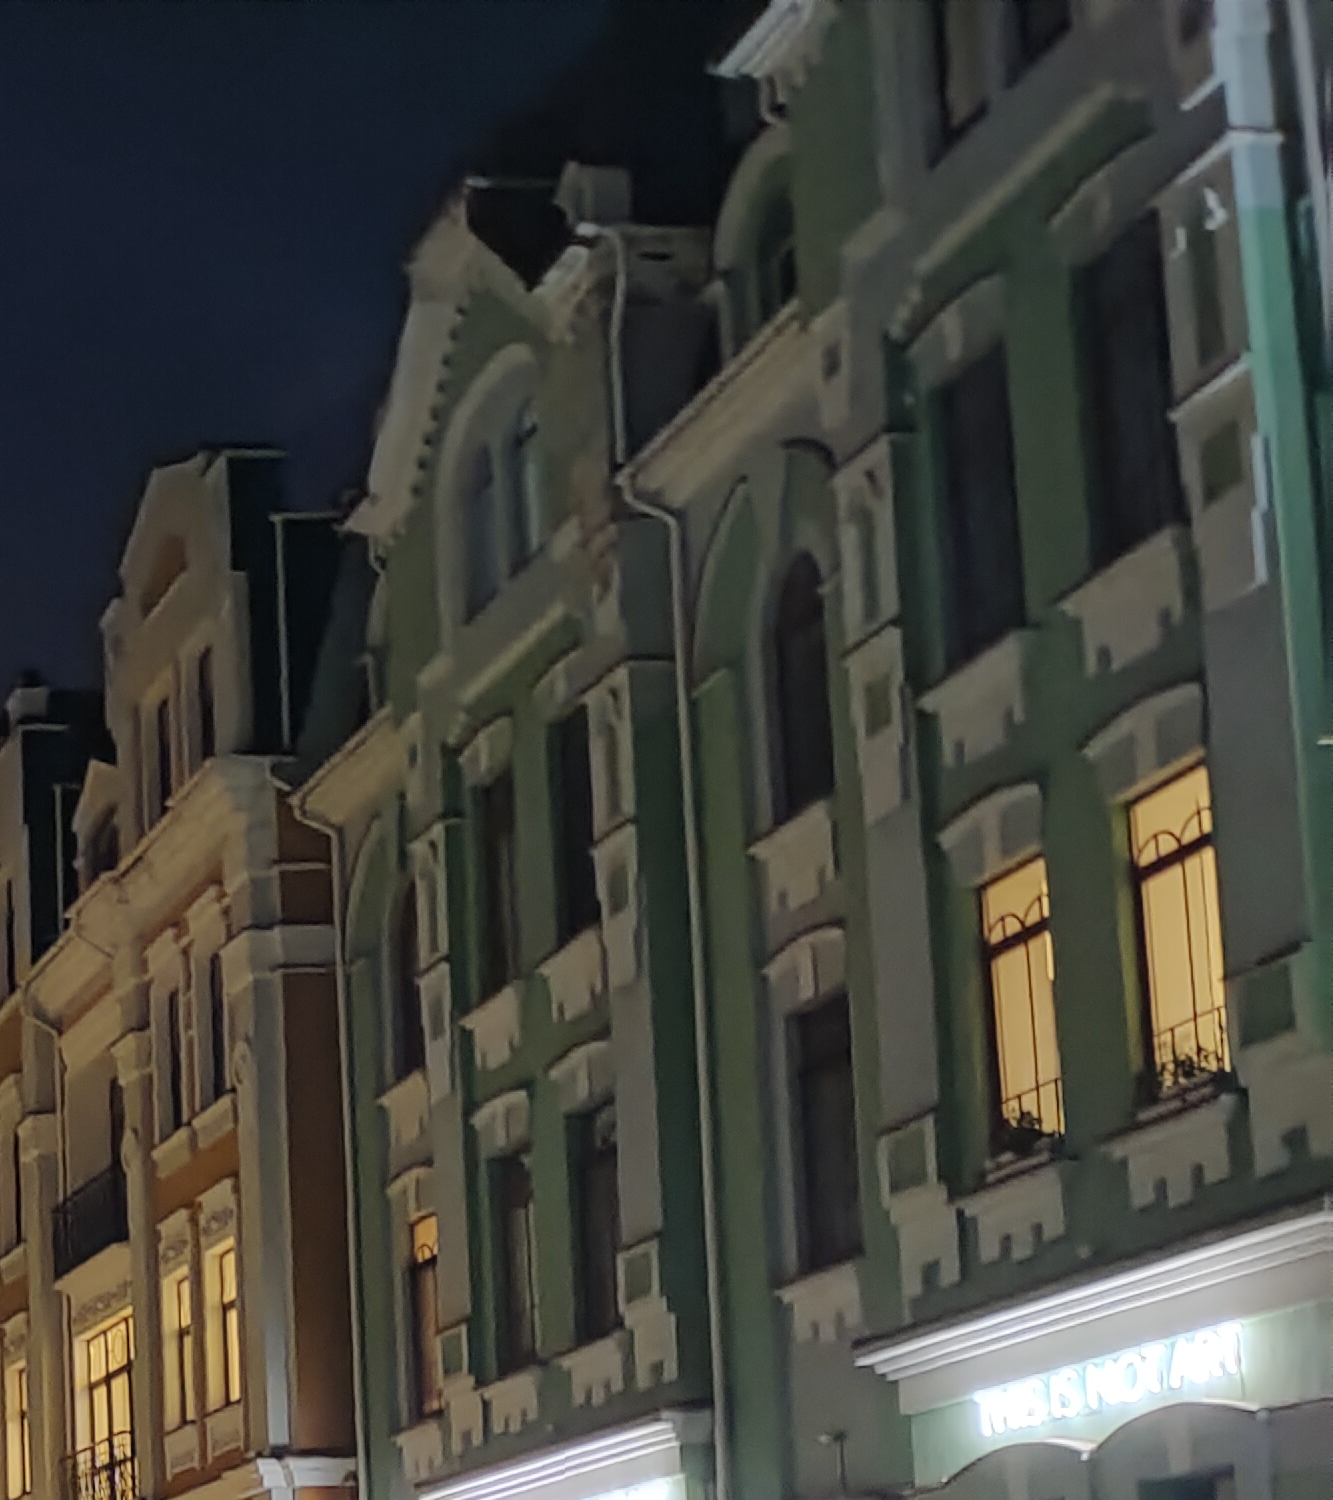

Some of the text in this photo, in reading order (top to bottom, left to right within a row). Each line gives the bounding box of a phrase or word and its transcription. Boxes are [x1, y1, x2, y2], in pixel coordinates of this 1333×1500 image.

[973, 1322, 1242, 1437] THIS IS NOT ART
